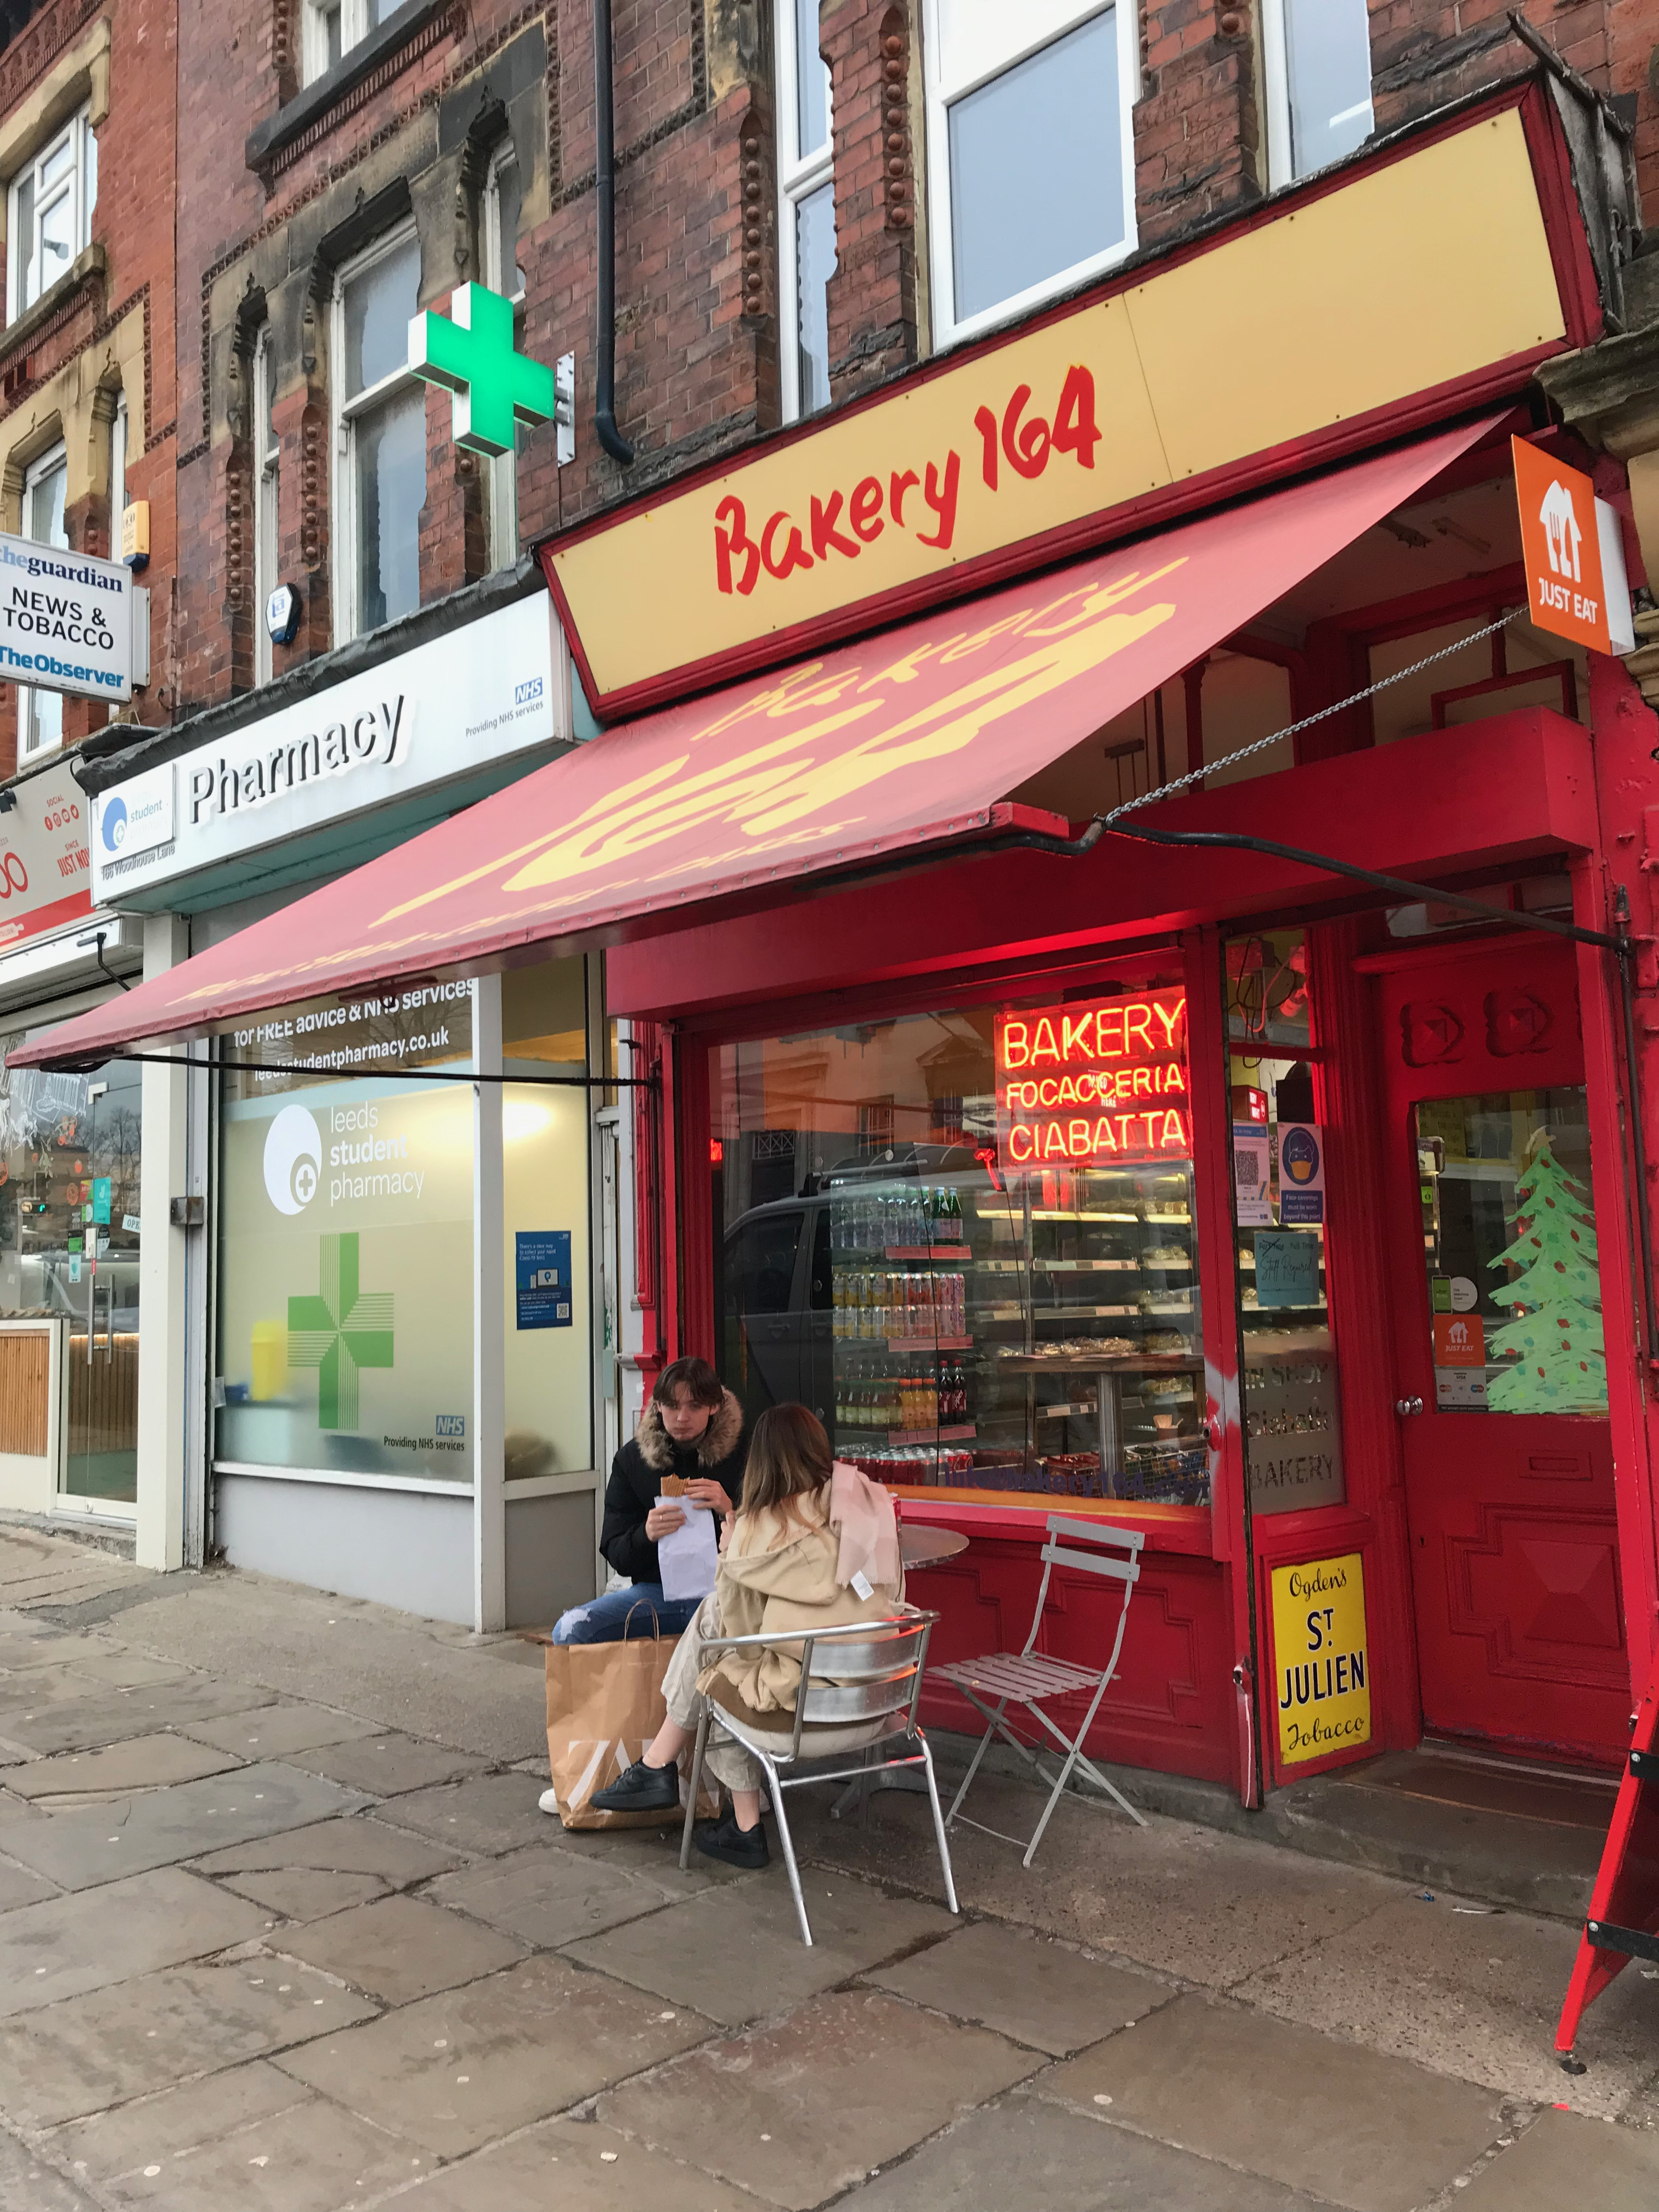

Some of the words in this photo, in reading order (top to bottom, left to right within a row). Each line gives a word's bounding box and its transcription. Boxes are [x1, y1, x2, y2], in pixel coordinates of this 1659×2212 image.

[715, 451, 960, 595] Bakery
[974, 364, 1102, 491] 164
[12, 586, 82, 621] NEWS
[91, 607, 106, 627] &
[1538, 577, 1572, 613] JUST
[1573, 593, 1598, 624] EAT
[3, 607, 114, 650] TOBACCO
[690, 556, 1189, 741] Bakery
[516, 678, 542, 704] NHS
[466, 719, 498, 737] Providing
[499, 710, 514, 724] NHS
[515, 700, 544, 718] services
[189, 695, 404, 823] Pharmacy
[47, 794, 64, 808] SOCIAL
[131, 799, 163, 822] student
[57, 854, 77, 877] JUST
[114, 852, 156, 876] Woodhouse
[157, 842, 176, 860] Lane
[296, 1007, 346, 1034] advice
[349, 1003, 362, 1022] &
[1004, 997, 1187, 1070] BAKERY
[1006, 1063, 1186, 1109] FOCACCERIA
[331, 1101, 379, 1133] leeds
[330, 1132, 408, 1167] student
[1009, 1109, 1187, 1161] CIABATTA
[330, 1169, 425, 1207] pharmacy
[1260, 1255, 1279, 1282] Staff
[383, 1435, 417, 1451] Providing
[419, 1437, 433, 1449] NHS
[435, 1439, 465, 1451] services
[437, 1417, 464, 1435] NHS
[1289, 1567, 1347, 1602] Ogden's
[1279, 1650, 1365, 1710] JULIEN
[1287, 1717, 1365, 1751] Tobacco
